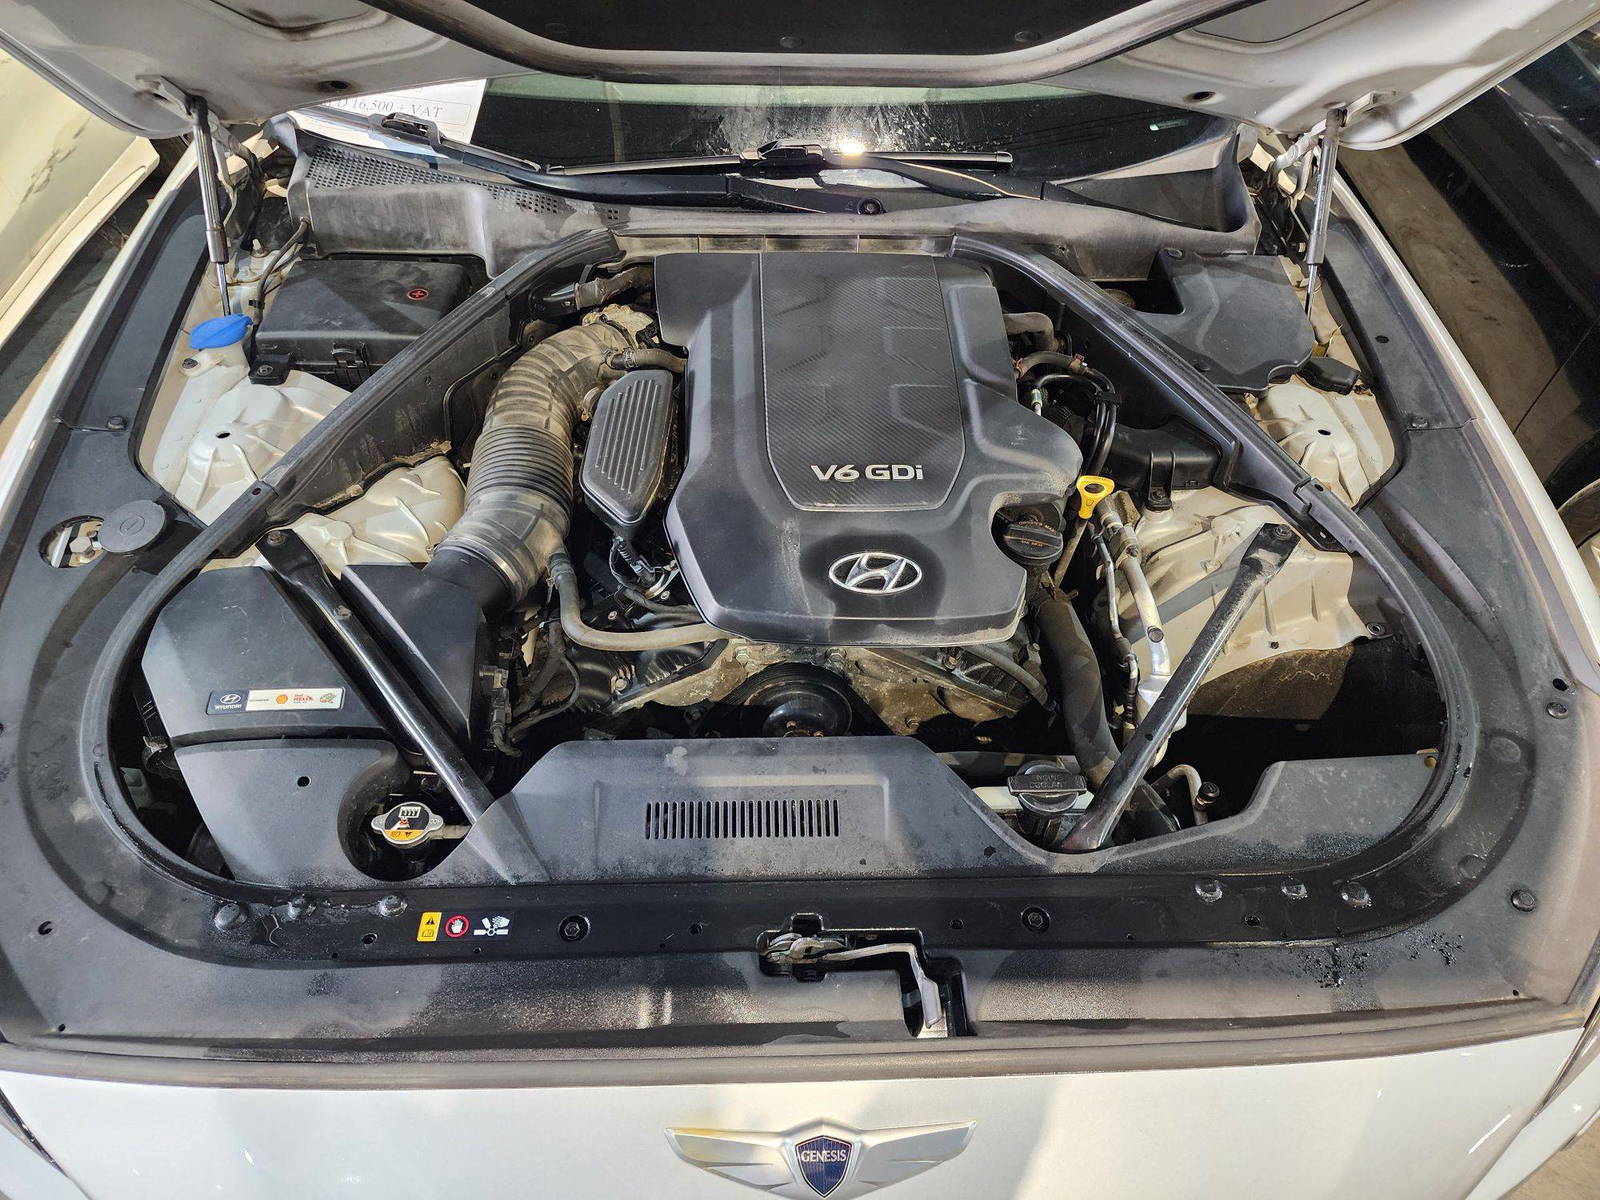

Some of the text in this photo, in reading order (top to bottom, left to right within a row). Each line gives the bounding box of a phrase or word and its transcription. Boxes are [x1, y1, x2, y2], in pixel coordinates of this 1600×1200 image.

[354, 98, 394, 113] 16,500
[411, 103, 443, 118] VAT
[810, 464, 924, 483] V6 GDi
[801, 1150, 847, 1163] GENESIS
